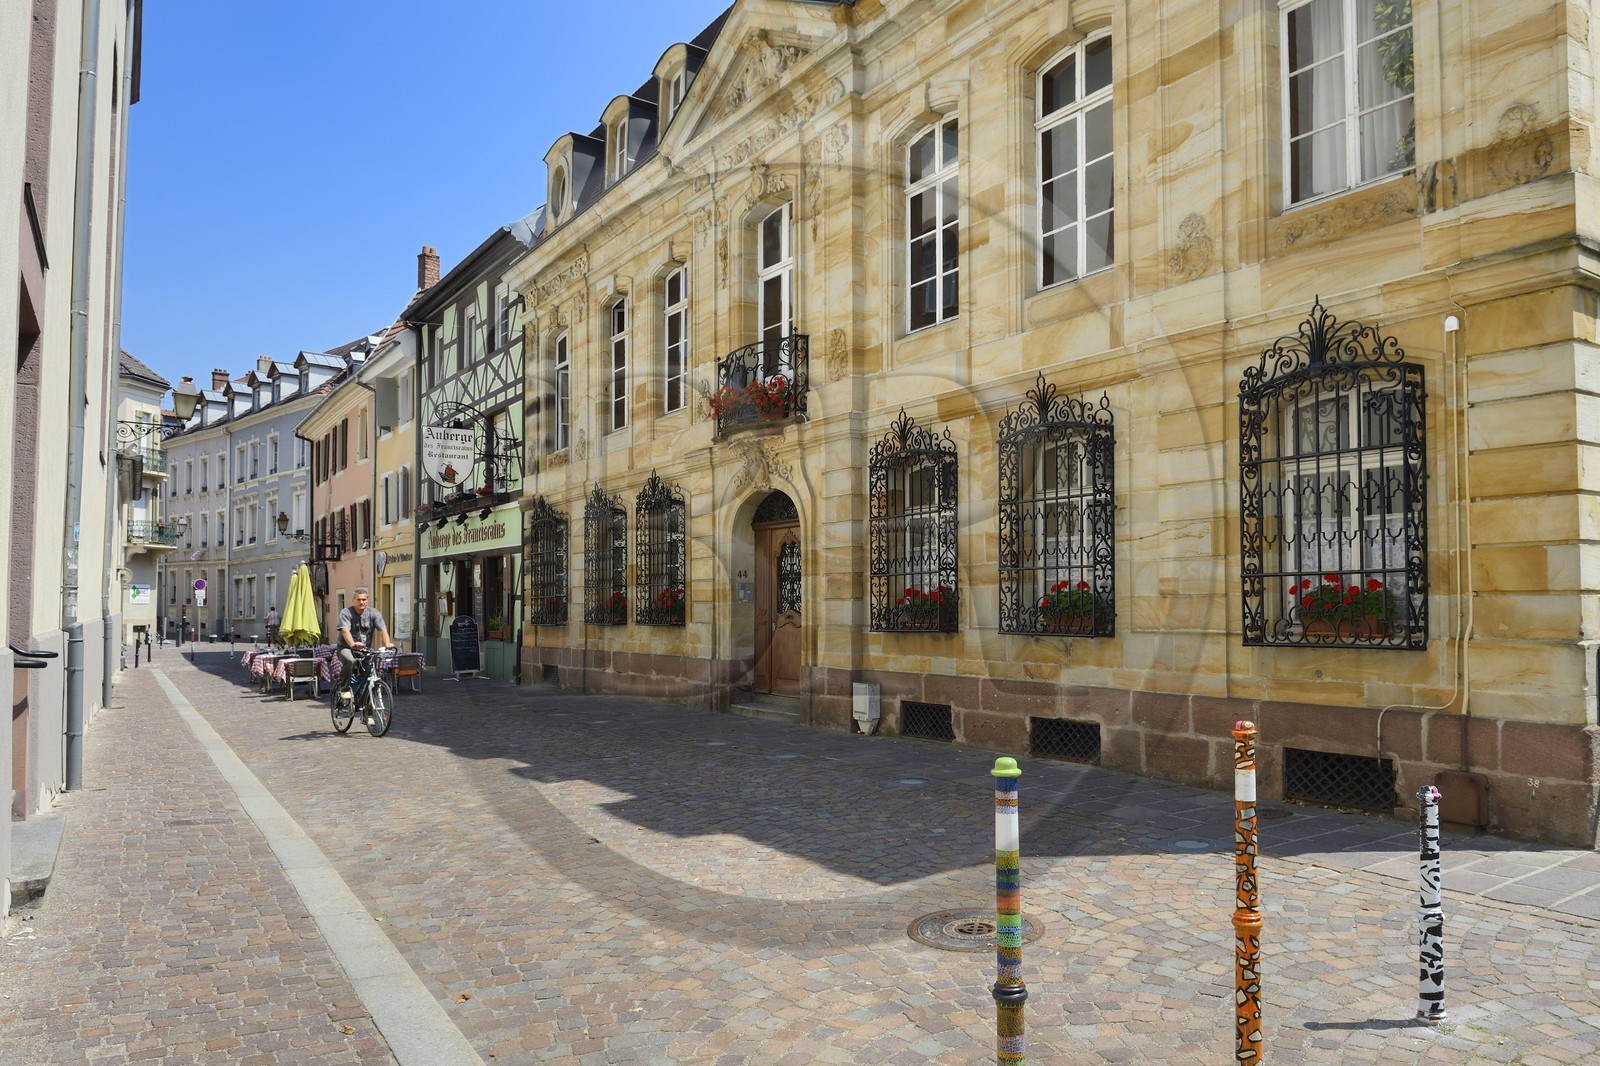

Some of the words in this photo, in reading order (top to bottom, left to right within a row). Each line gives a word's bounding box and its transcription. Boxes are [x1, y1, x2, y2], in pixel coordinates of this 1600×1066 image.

[425, 427, 473, 444] Auberge
[436, 442, 473, 451] Franciscains
[428, 451, 469, 459] Restaurant
[428, 530, 451, 552] Auberge
[452, 527, 462, 546] des
[463, 520, 505, 544] Franciscains
[737, 570, 748, 578] 44
[1527, 778, 1540, 788] 38
